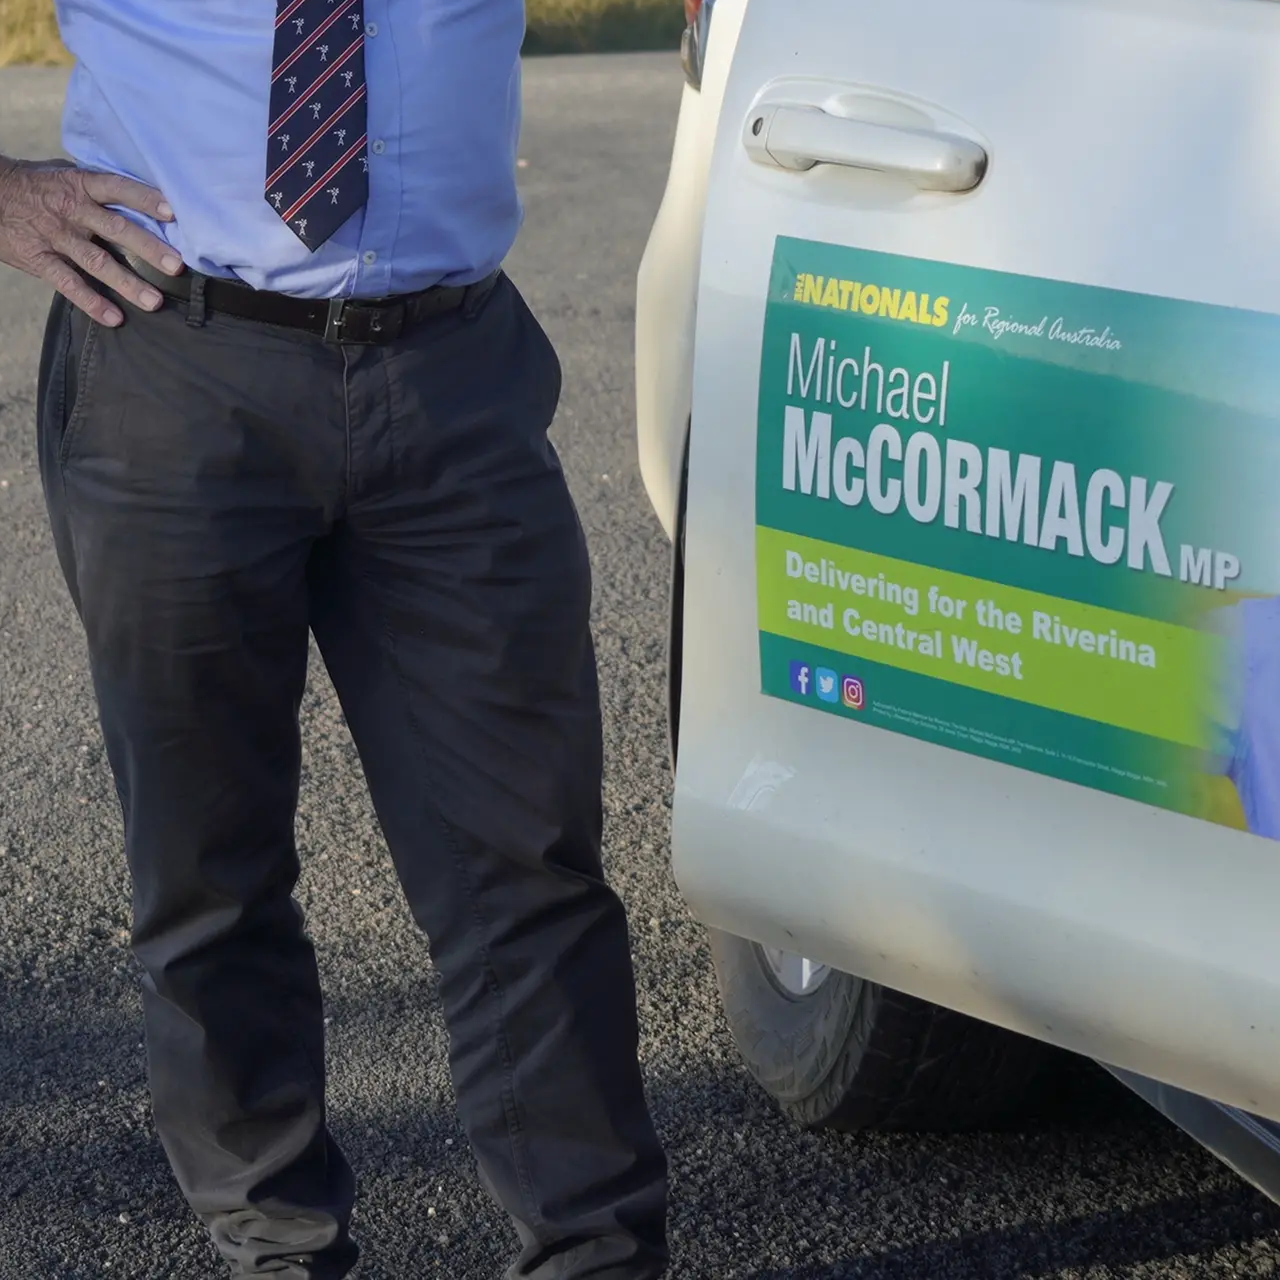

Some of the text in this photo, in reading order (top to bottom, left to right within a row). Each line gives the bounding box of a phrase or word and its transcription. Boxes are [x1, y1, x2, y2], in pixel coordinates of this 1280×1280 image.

[803, 273, 950, 327] NATIONALS
[953, 303, 978, 335] for
[982, 306, 1048, 340] Regional
[1048, 317, 1122, 350] Australia
[787, 332, 949, 426] Michael
[782, 405, 1241, 590] McCORMACK MP
[785, 550, 1156, 667] Delivering for the Riverina
[786, 596, 1023, 680] and Central West
